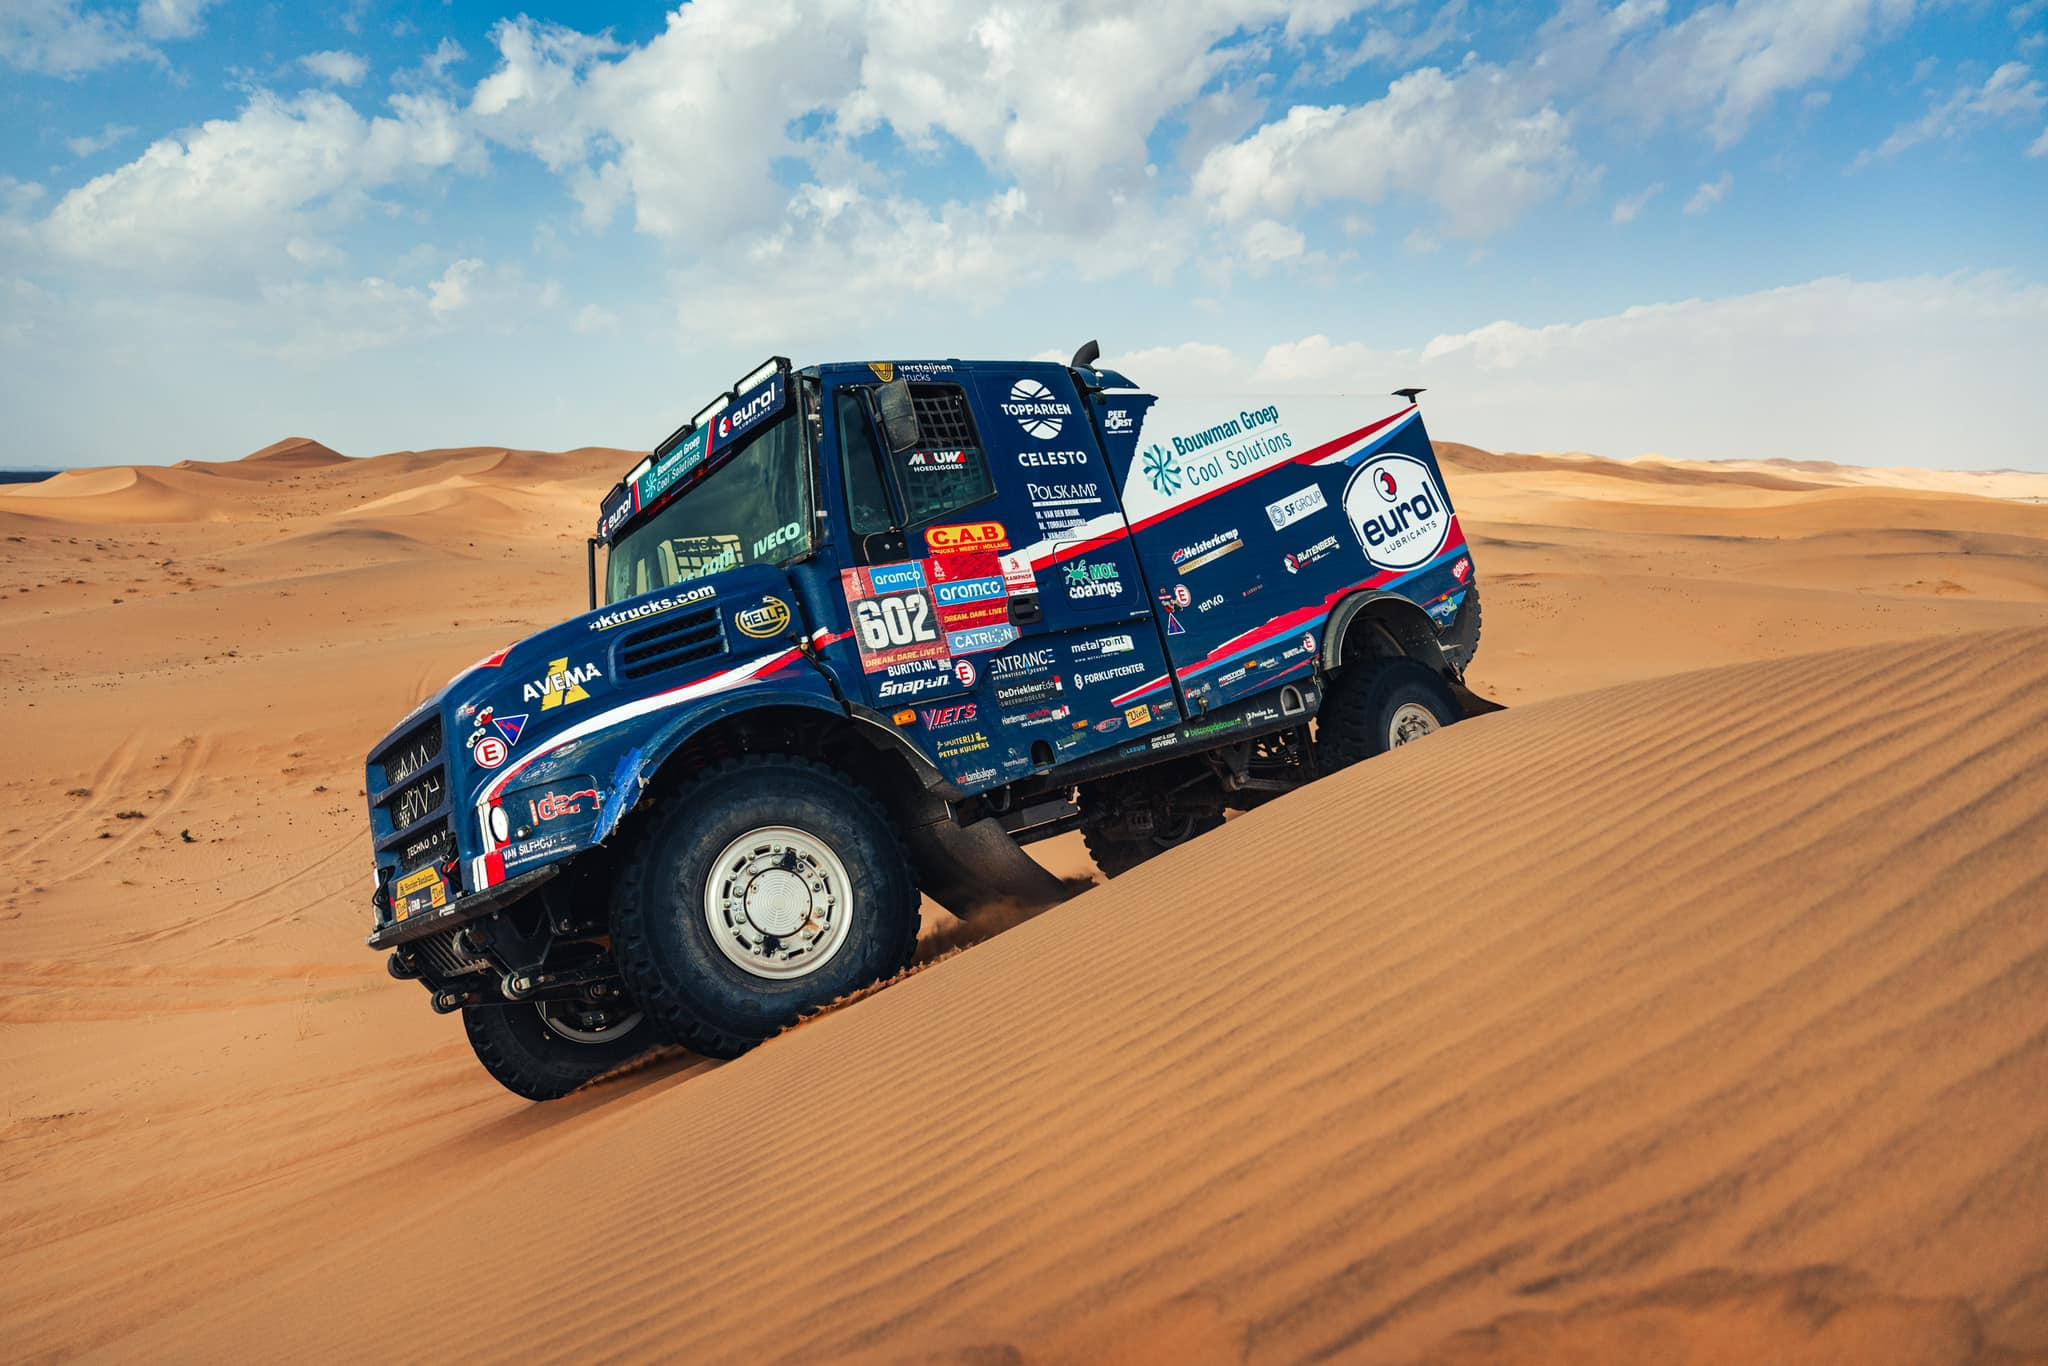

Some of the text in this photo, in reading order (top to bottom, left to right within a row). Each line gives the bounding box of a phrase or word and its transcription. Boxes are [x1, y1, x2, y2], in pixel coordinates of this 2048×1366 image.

[898, 363, 954, 374] versteijnen
[902, 373, 931, 382] trucks
[732, 382, 776, 427] eurol
[1001, 403, 1072, 416] TOPPARKEN
[1171, 404, 1280, 457] Bouwman Groep
[671, 451, 701, 480] Solutions
[913, 463, 964, 473] HOEDLIGGERS
[1018, 450, 1088, 467] CELESTO
[1186, 432, 1293, 487] Cool Solutions
[1027, 483, 1098, 500] POLSKAMP
[608, 492, 632, 528] eurol
[1362, 480, 1440, 547] eurol
[753, 521, 801, 559] IVECO
[933, 525, 1000, 545] C.A.B
[1183, 527, 1239, 559] Heisterkamp
[1384, 520, 1438, 554] LUBRICANTS
[874, 569, 921, 585] aramco
[1090, 562, 1119, 580] MOL
[940, 580, 1002, 601] aramco
[1069, 579, 1123, 599] coatings
[743, 602, 788, 628] HELLA
[856, 593, 937, 650] 602
[944, 611, 969, 624] DREAM.
[969, 609, 988, 621] DARE.
[988, 607, 1002, 616] LIVE
[955, 627, 1014, 649] CATRION
[865, 647, 945, 668] DREAM. DARE. LIVE IT.
[988, 648, 1056, 676] ENTRANCE
[887, 660, 937, 677] BURITO.NL
[1084, 662, 1146, 685] FORKLIFTCENTER
[523, 662, 602, 702] AVEMA
[878, 674, 949, 698] Snap-on
[939, 749, 959, 759] PETER
[502, 847, 518, 861] VAN
